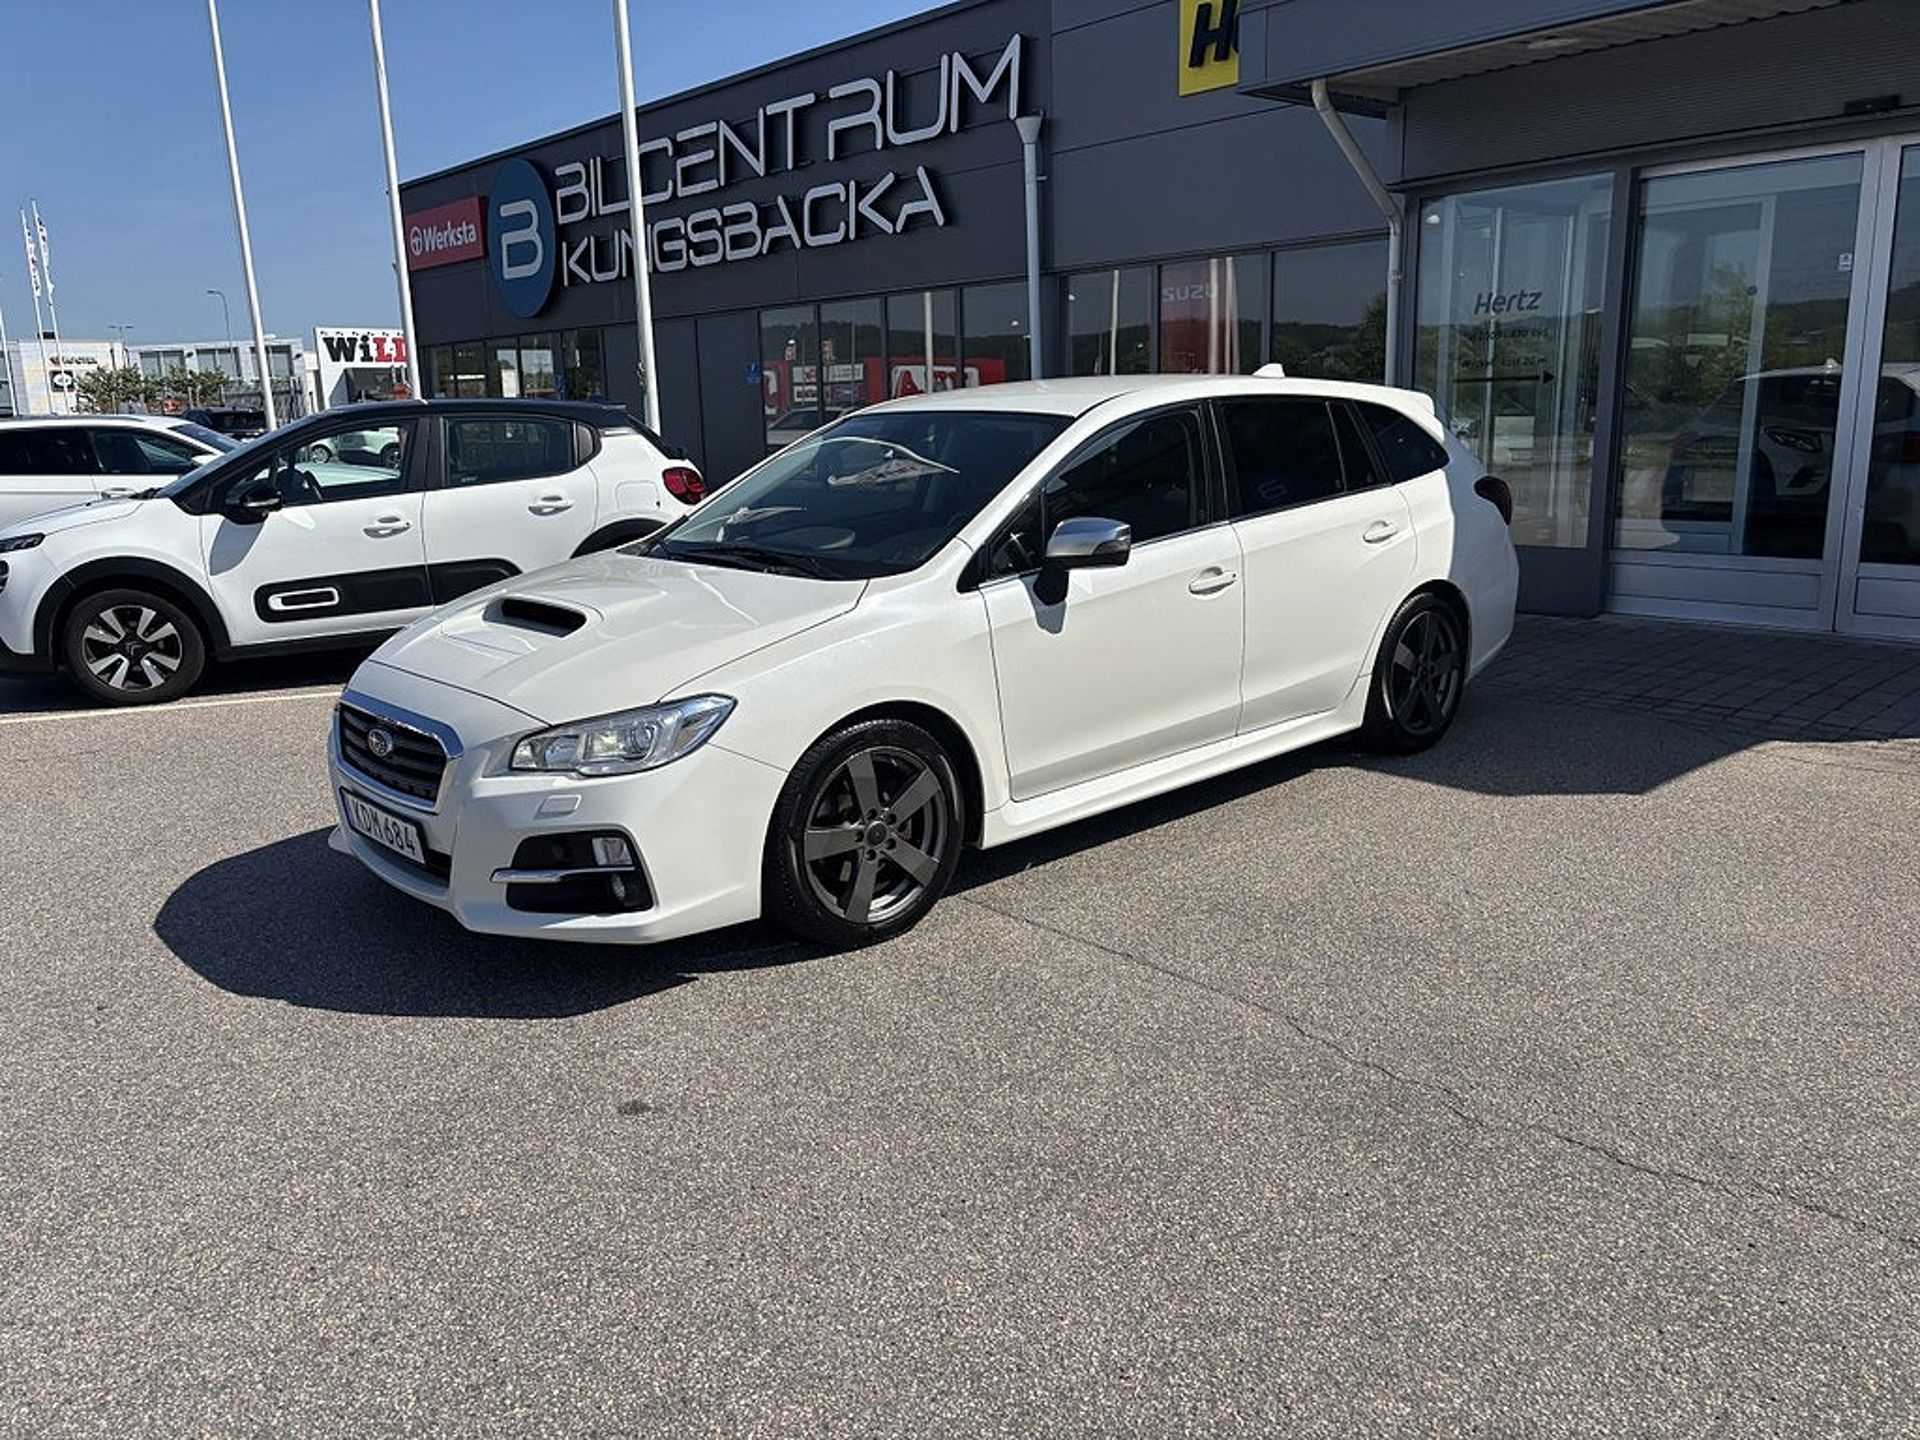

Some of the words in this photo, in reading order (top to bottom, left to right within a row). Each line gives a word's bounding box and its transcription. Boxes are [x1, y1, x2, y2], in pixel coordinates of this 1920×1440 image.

[1188, 0, 1239, 69] H
[554, 33, 1021, 225] BILCENTRUM
[423, 219, 478, 254] Werksta
[500, 199, 544, 281] B
[561, 166, 945, 287] KUNGSBACKA
[1474, 290, 1543, 315] Hertz
[384, 817, 416, 857] 684
